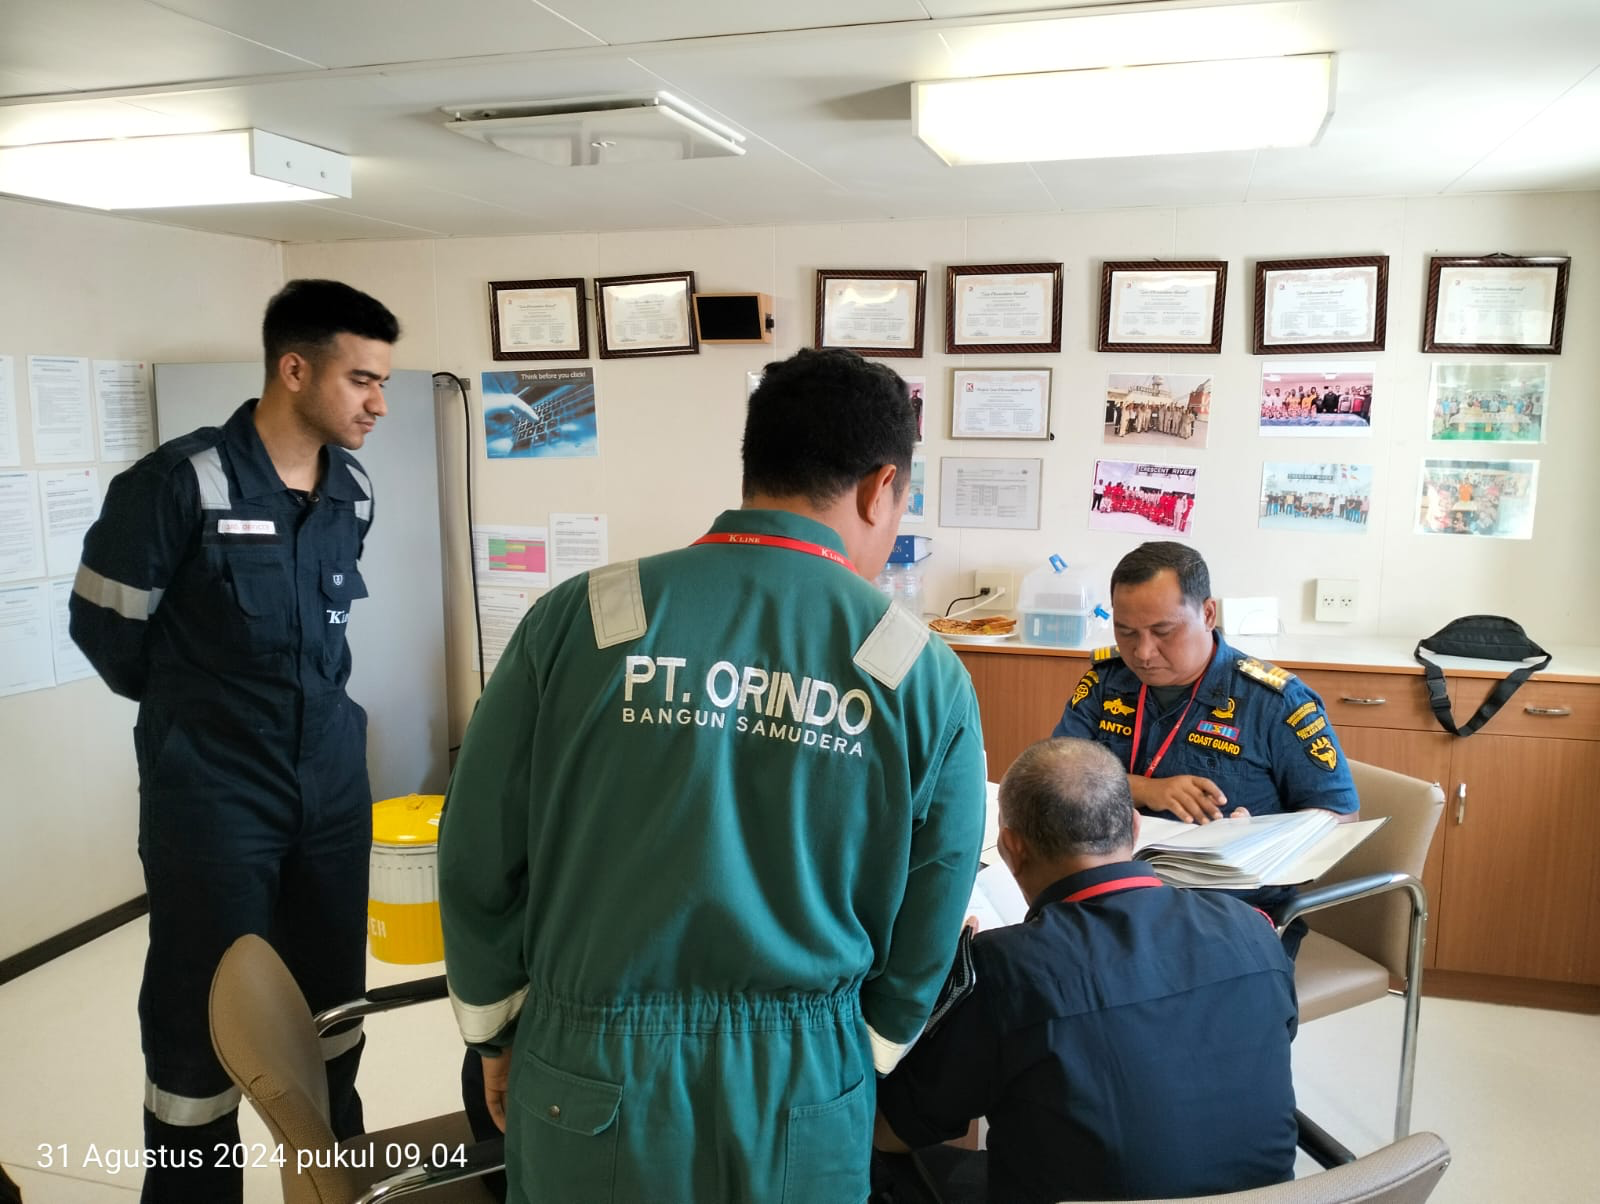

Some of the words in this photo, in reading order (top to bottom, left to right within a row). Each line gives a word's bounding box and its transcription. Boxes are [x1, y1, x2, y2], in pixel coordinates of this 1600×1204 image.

[1139, 466, 1169, 474] CRESCENT
[1172, 468, 1195, 476] RIVER
[728, 534, 738, 543] K
[821, 548, 829, 556] K
[624, 655, 691, 703] PT.
[706, 660, 872, 736] ORINDO
[622, 707, 725, 729] BANGUN
[736, 716, 863, 758] SAMUDERA
[1099, 720, 1132, 736] ANTO
[1188, 732, 1213, 747] COAST
[1212, 739, 1240, 755] GUARD
